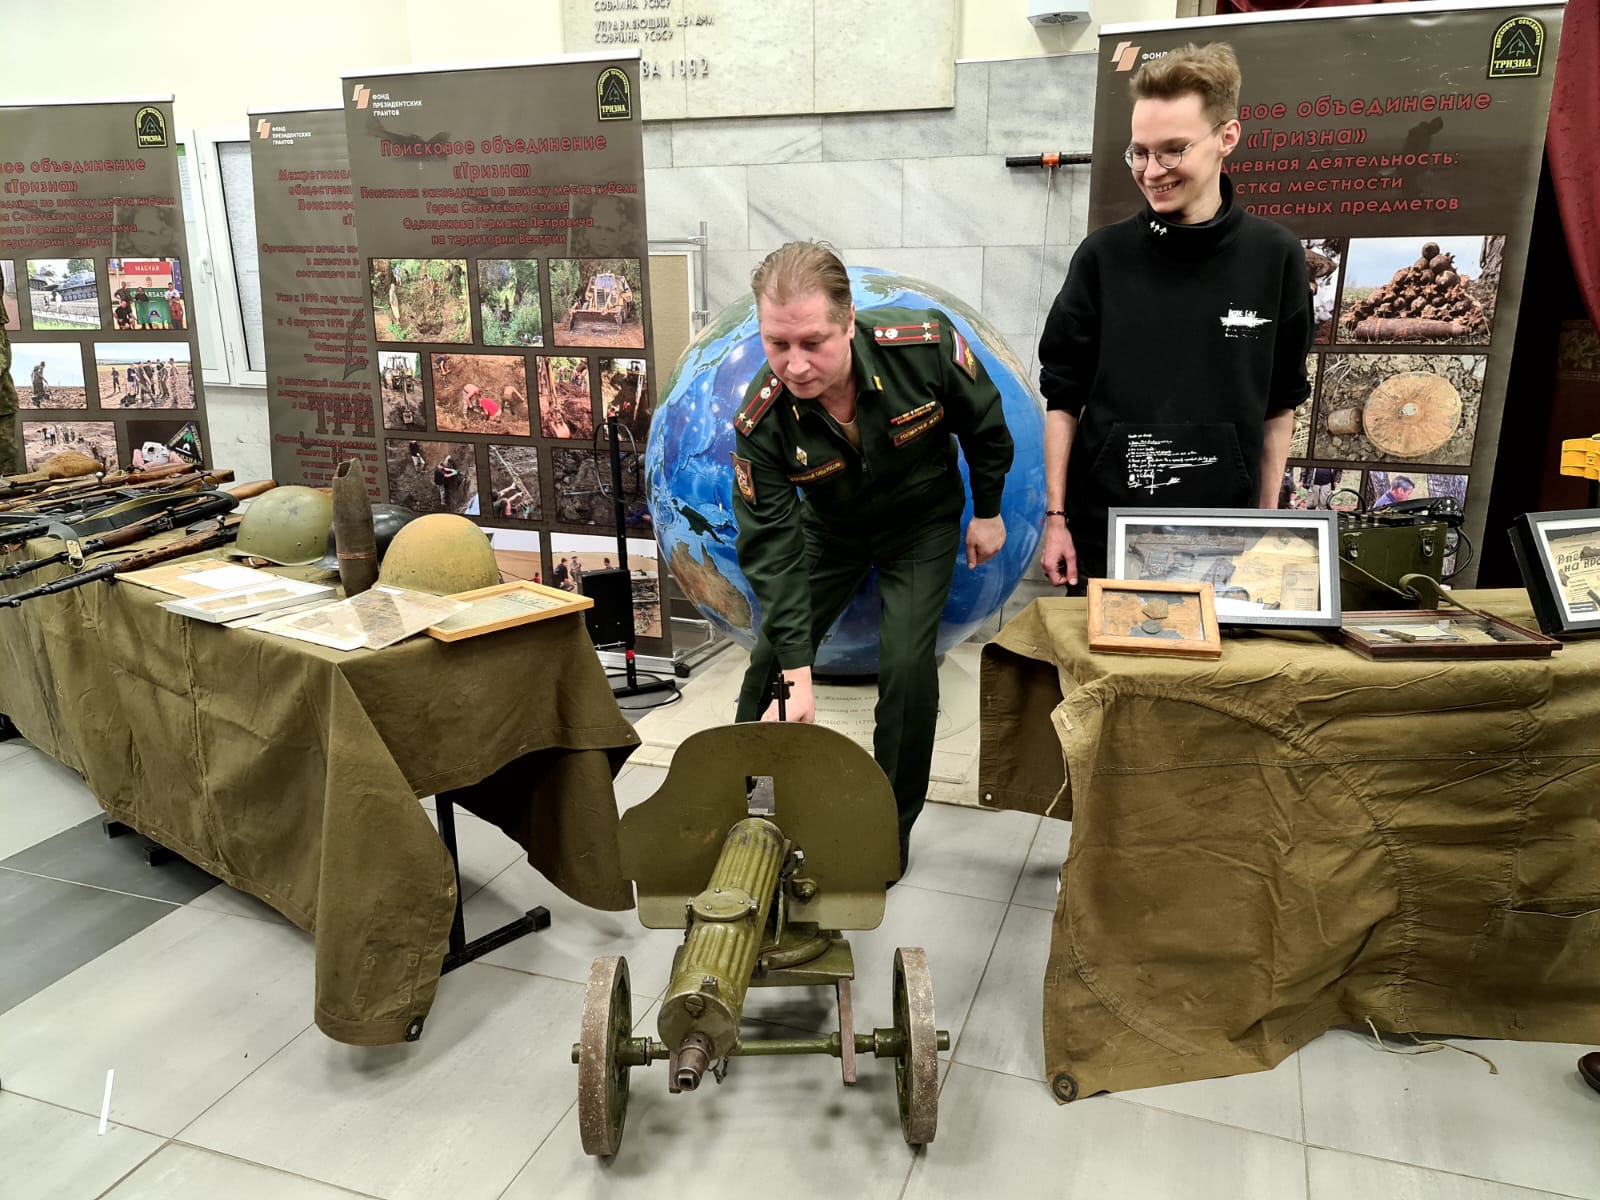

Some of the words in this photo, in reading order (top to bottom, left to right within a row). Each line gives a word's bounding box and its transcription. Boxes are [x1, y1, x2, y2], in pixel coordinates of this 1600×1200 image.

[671, 58, 710, 79] 1992
[1494, 58, 1532, 69] ТРИЗНА
[372, 93, 390, 101] ФОНД
[372, 100, 422, 109] ПРЕЗИДЕНТСКИХ
[1296, 92, 1492, 119] объединение
[373, 109, 400, 117] ГРАНТОВ
[380, 138, 476, 157] Поисковое
[481, 134, 607, 154] объединение
[1247, 127, 1368, 152] «Тризна»
[31, 157, 146, 175] объединение
[1305, 152, 1461, 172] деятельность:
[453, 161, 532, 181] «Тризна»
[4, 178, 78, 195] «Тризна»
[508, 185, 550, 199] поиску
[553, 185, 593, 197] места
[1235, 181, 1281, 195] стка
[1287, 176, 1404, 193] местности
[461, 200, 529, 214] Советского
[532, 201, 570, 213] союза
[1245, 201, 1333, 217] опасных
[1340, 198, 1460, 216] предметов
[475, 215, 527, 231] Германа
[530, 216, 594, 230] Петровича
[431, 234, 446, 246] на
[448, 233, 516, 247] территории
[519, 232, 567, 246] Венгрии
